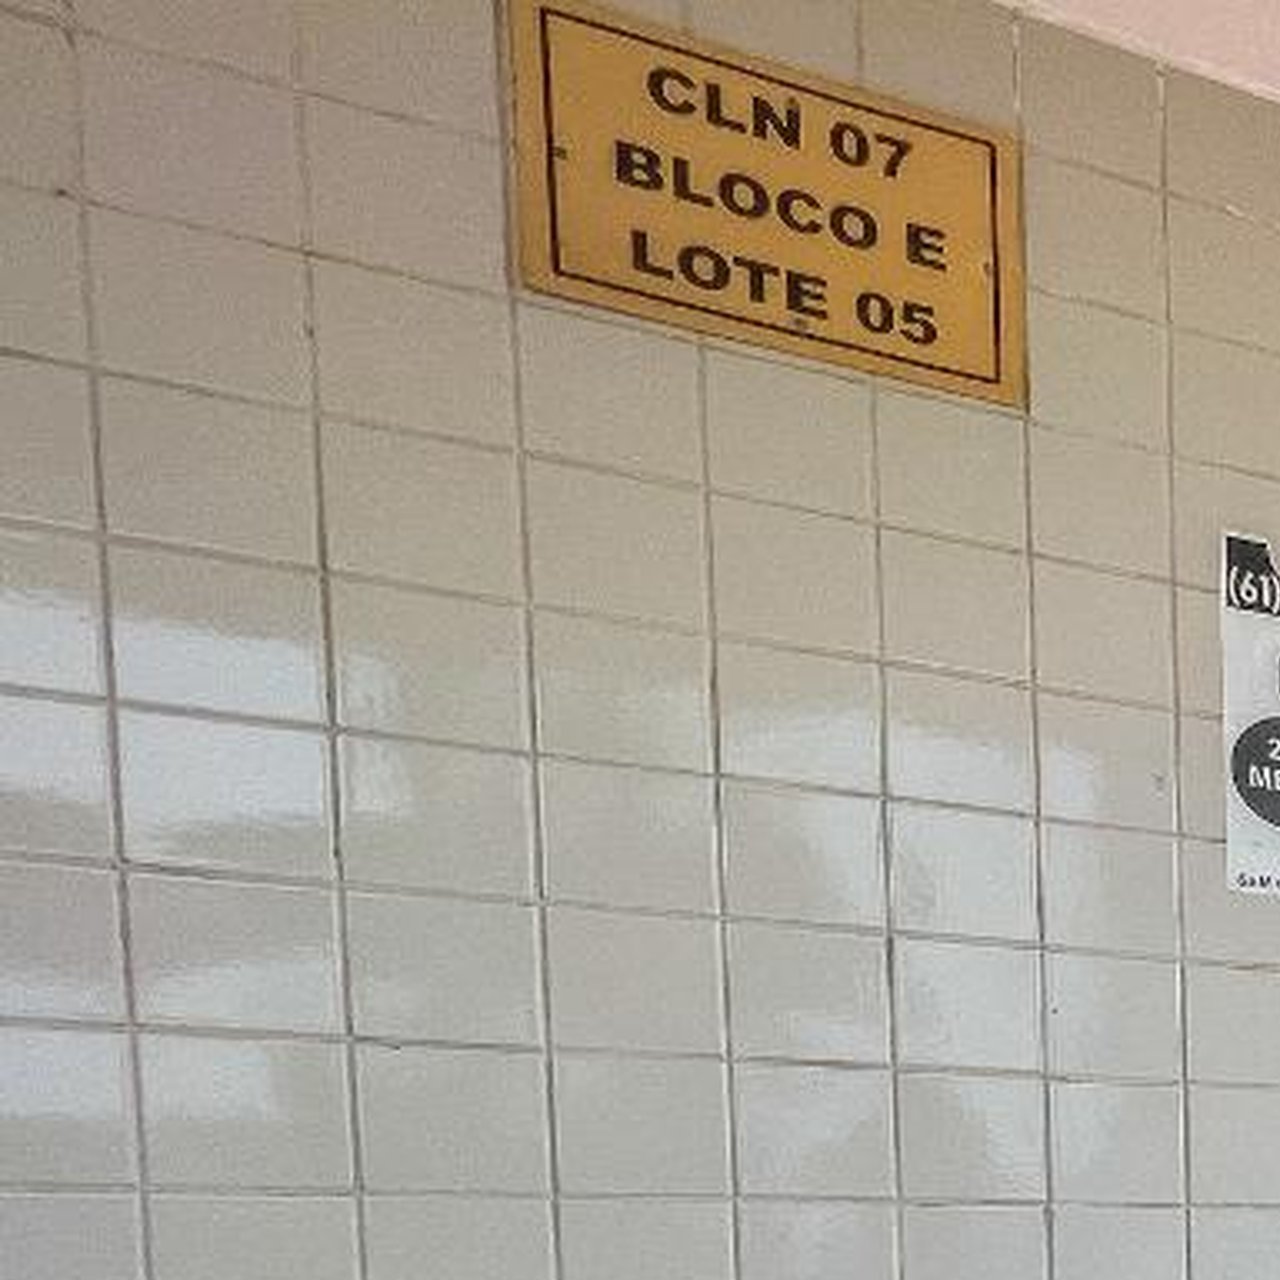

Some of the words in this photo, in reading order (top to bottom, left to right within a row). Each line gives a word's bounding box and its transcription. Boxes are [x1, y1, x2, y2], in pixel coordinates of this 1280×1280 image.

[647, 67, 801, 151] CLN
[829, 121, 912, 180] 07
[614, 139, 878, 249] BLOCO
[907, 222, 948, 272] E
[630, 230, 828, 321] LOTE
[856, 291, 938, 346] 05
